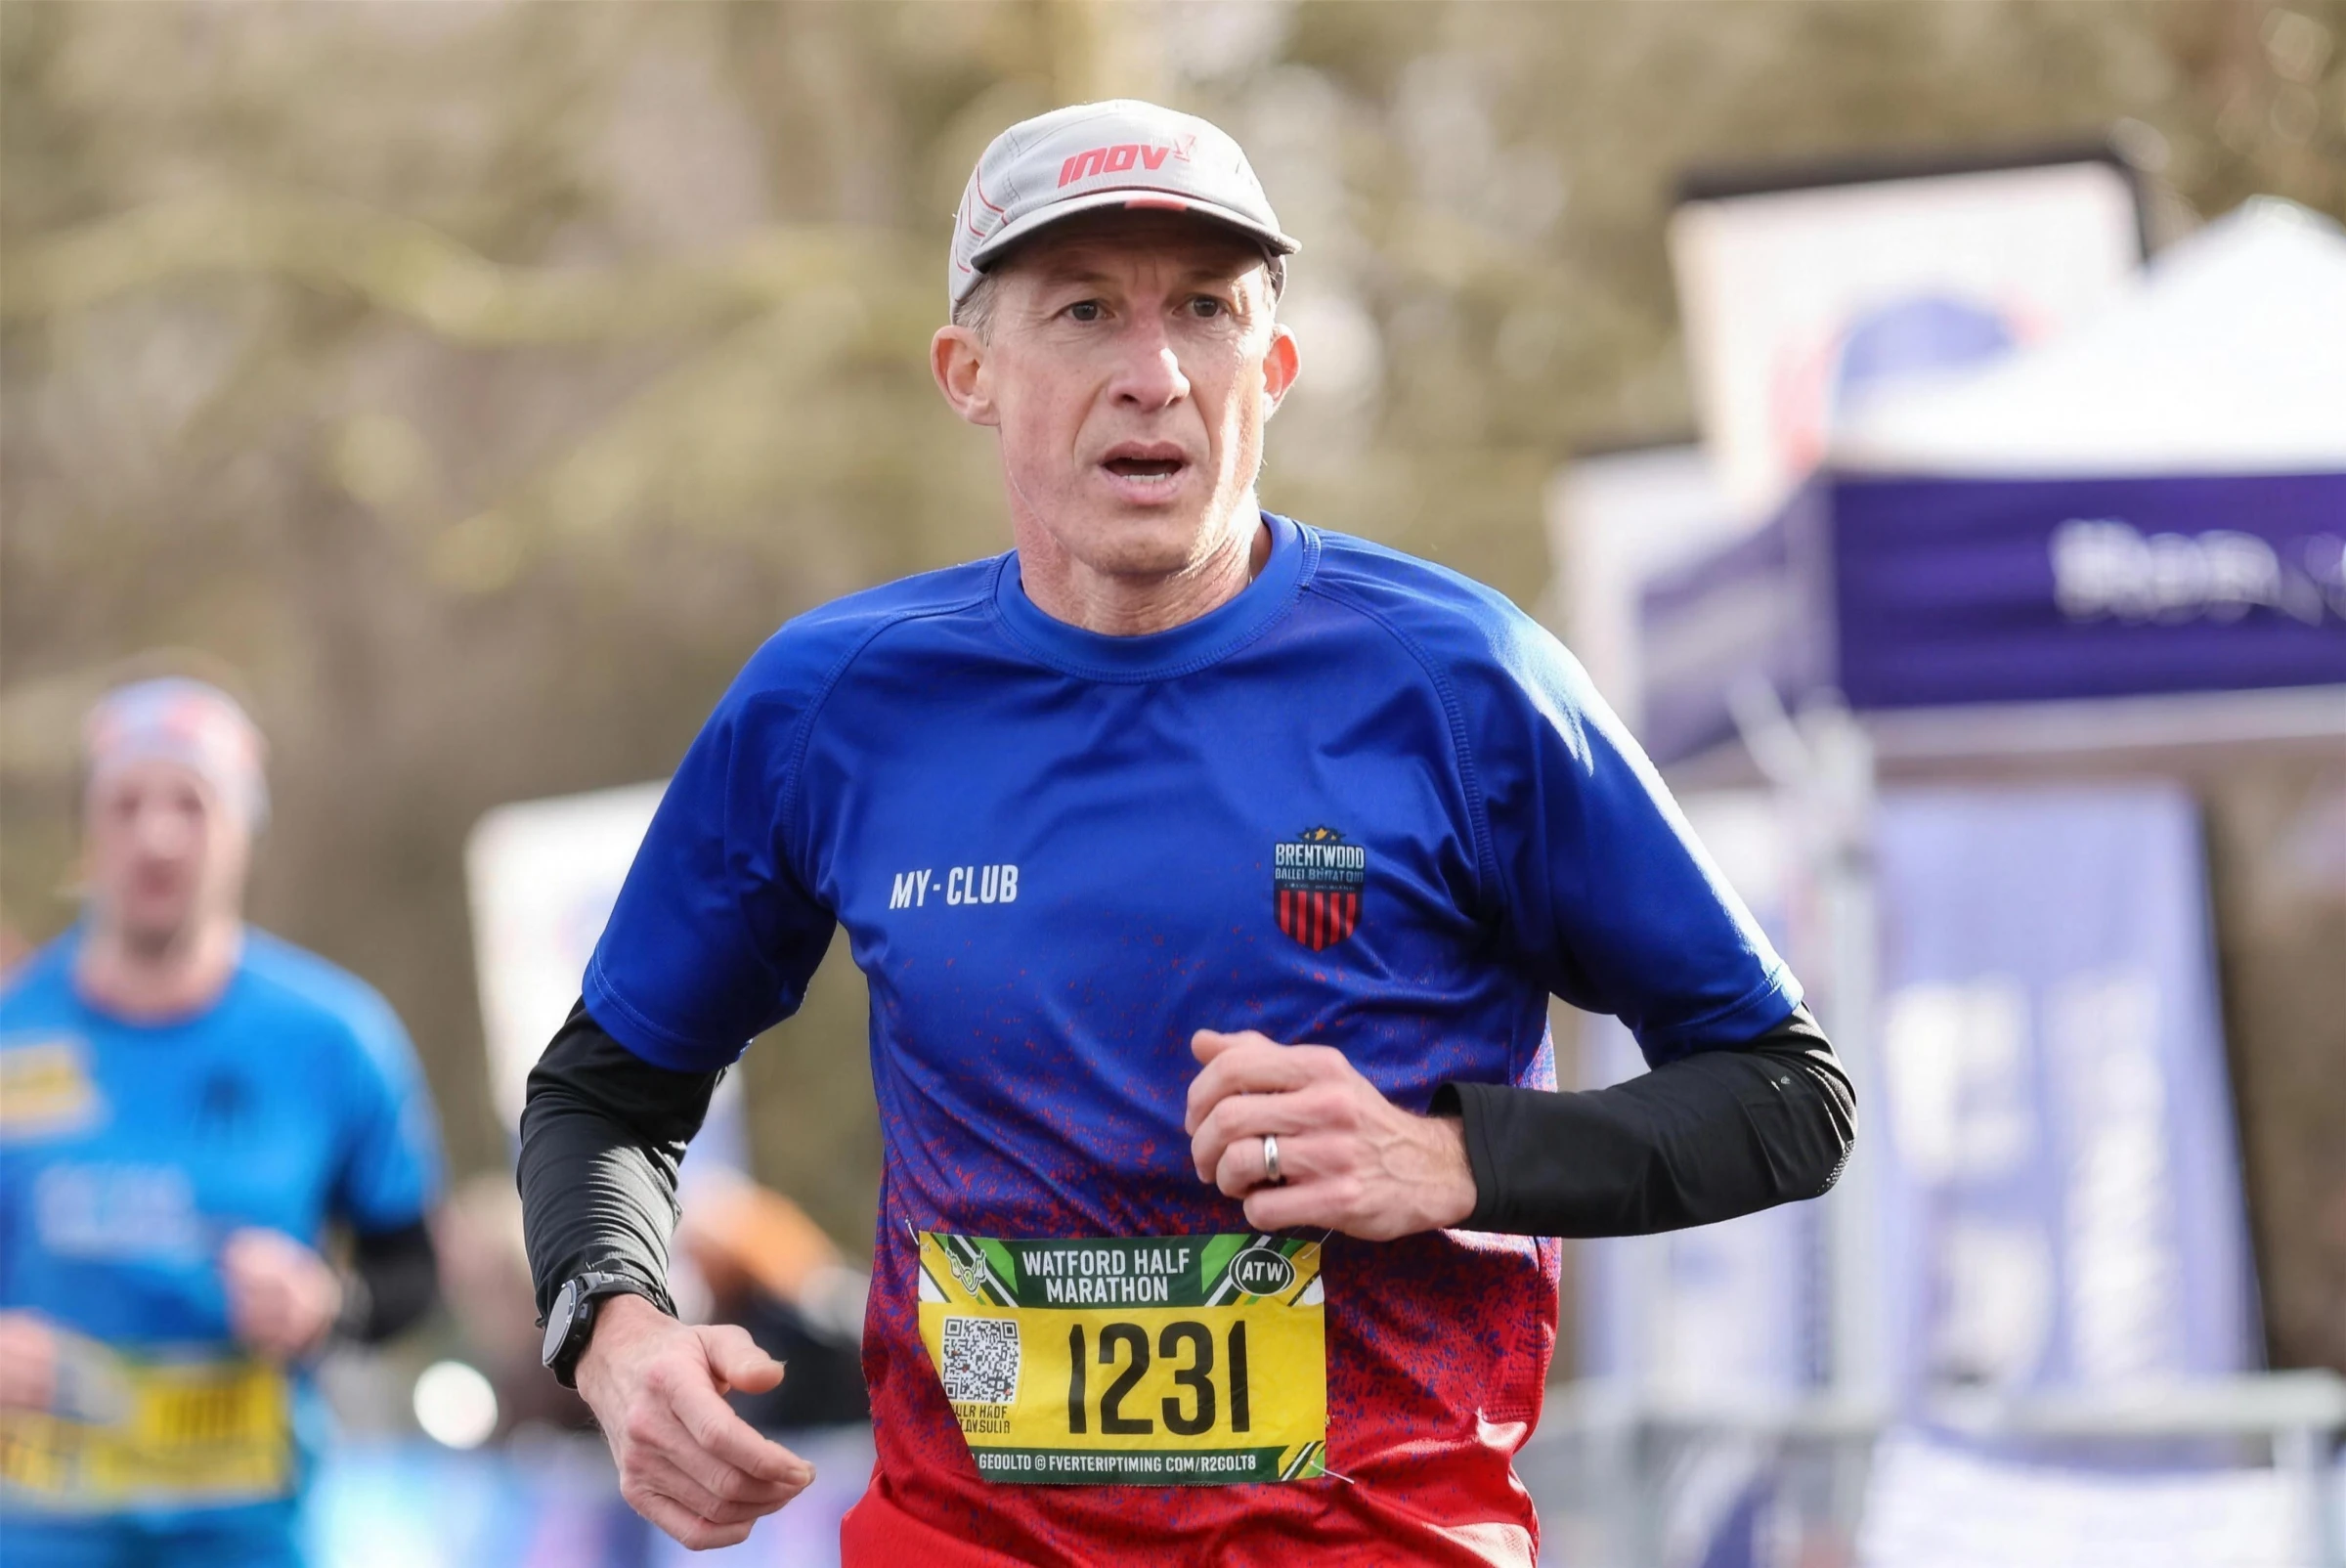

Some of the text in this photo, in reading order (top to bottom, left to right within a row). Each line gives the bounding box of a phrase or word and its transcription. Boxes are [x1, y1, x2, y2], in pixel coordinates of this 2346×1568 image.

[1275, 843, 1365, 869] BRENTWOOD
[1022, 1248, 1191, 1277] WATFORD HALF
[1241, 1261, 1284, 1282] ATW
[1045, 1276, 1168, 1303] MARATHON
[1068, 1320, 1250, 1436] 1231
